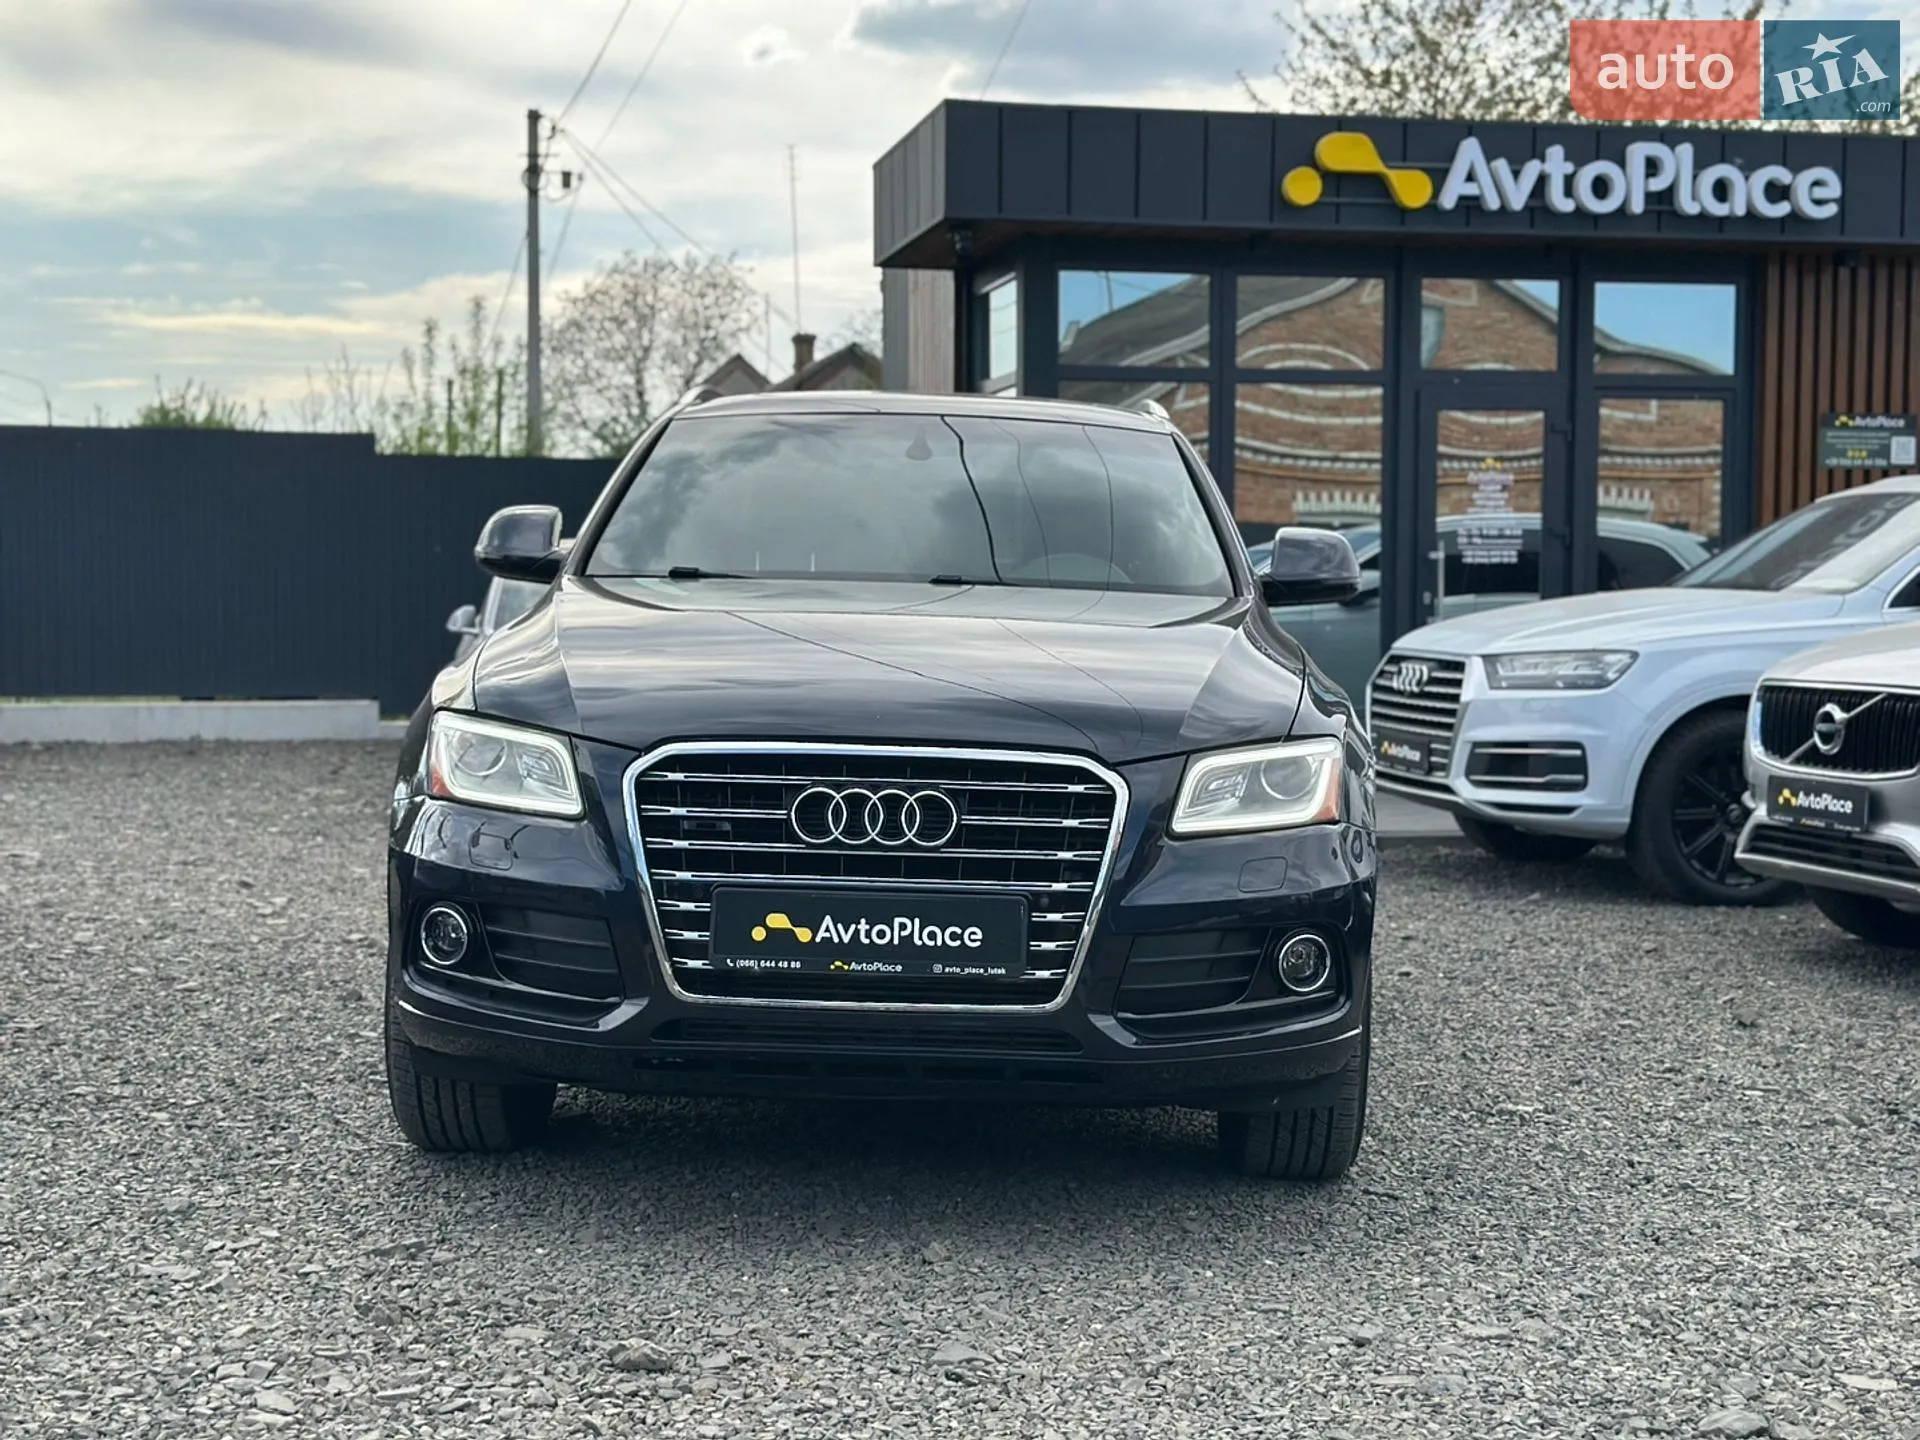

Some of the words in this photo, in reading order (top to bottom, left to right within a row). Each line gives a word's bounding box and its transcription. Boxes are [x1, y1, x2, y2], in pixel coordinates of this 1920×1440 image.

[1437, 136, 1843, 220] AvtoPlace
[1797, 791, 1853, 814] AvtoPlace
[815, 915, 983, 948] AvtoPlace
[849, 961, 903, 972] AvtoPlace
